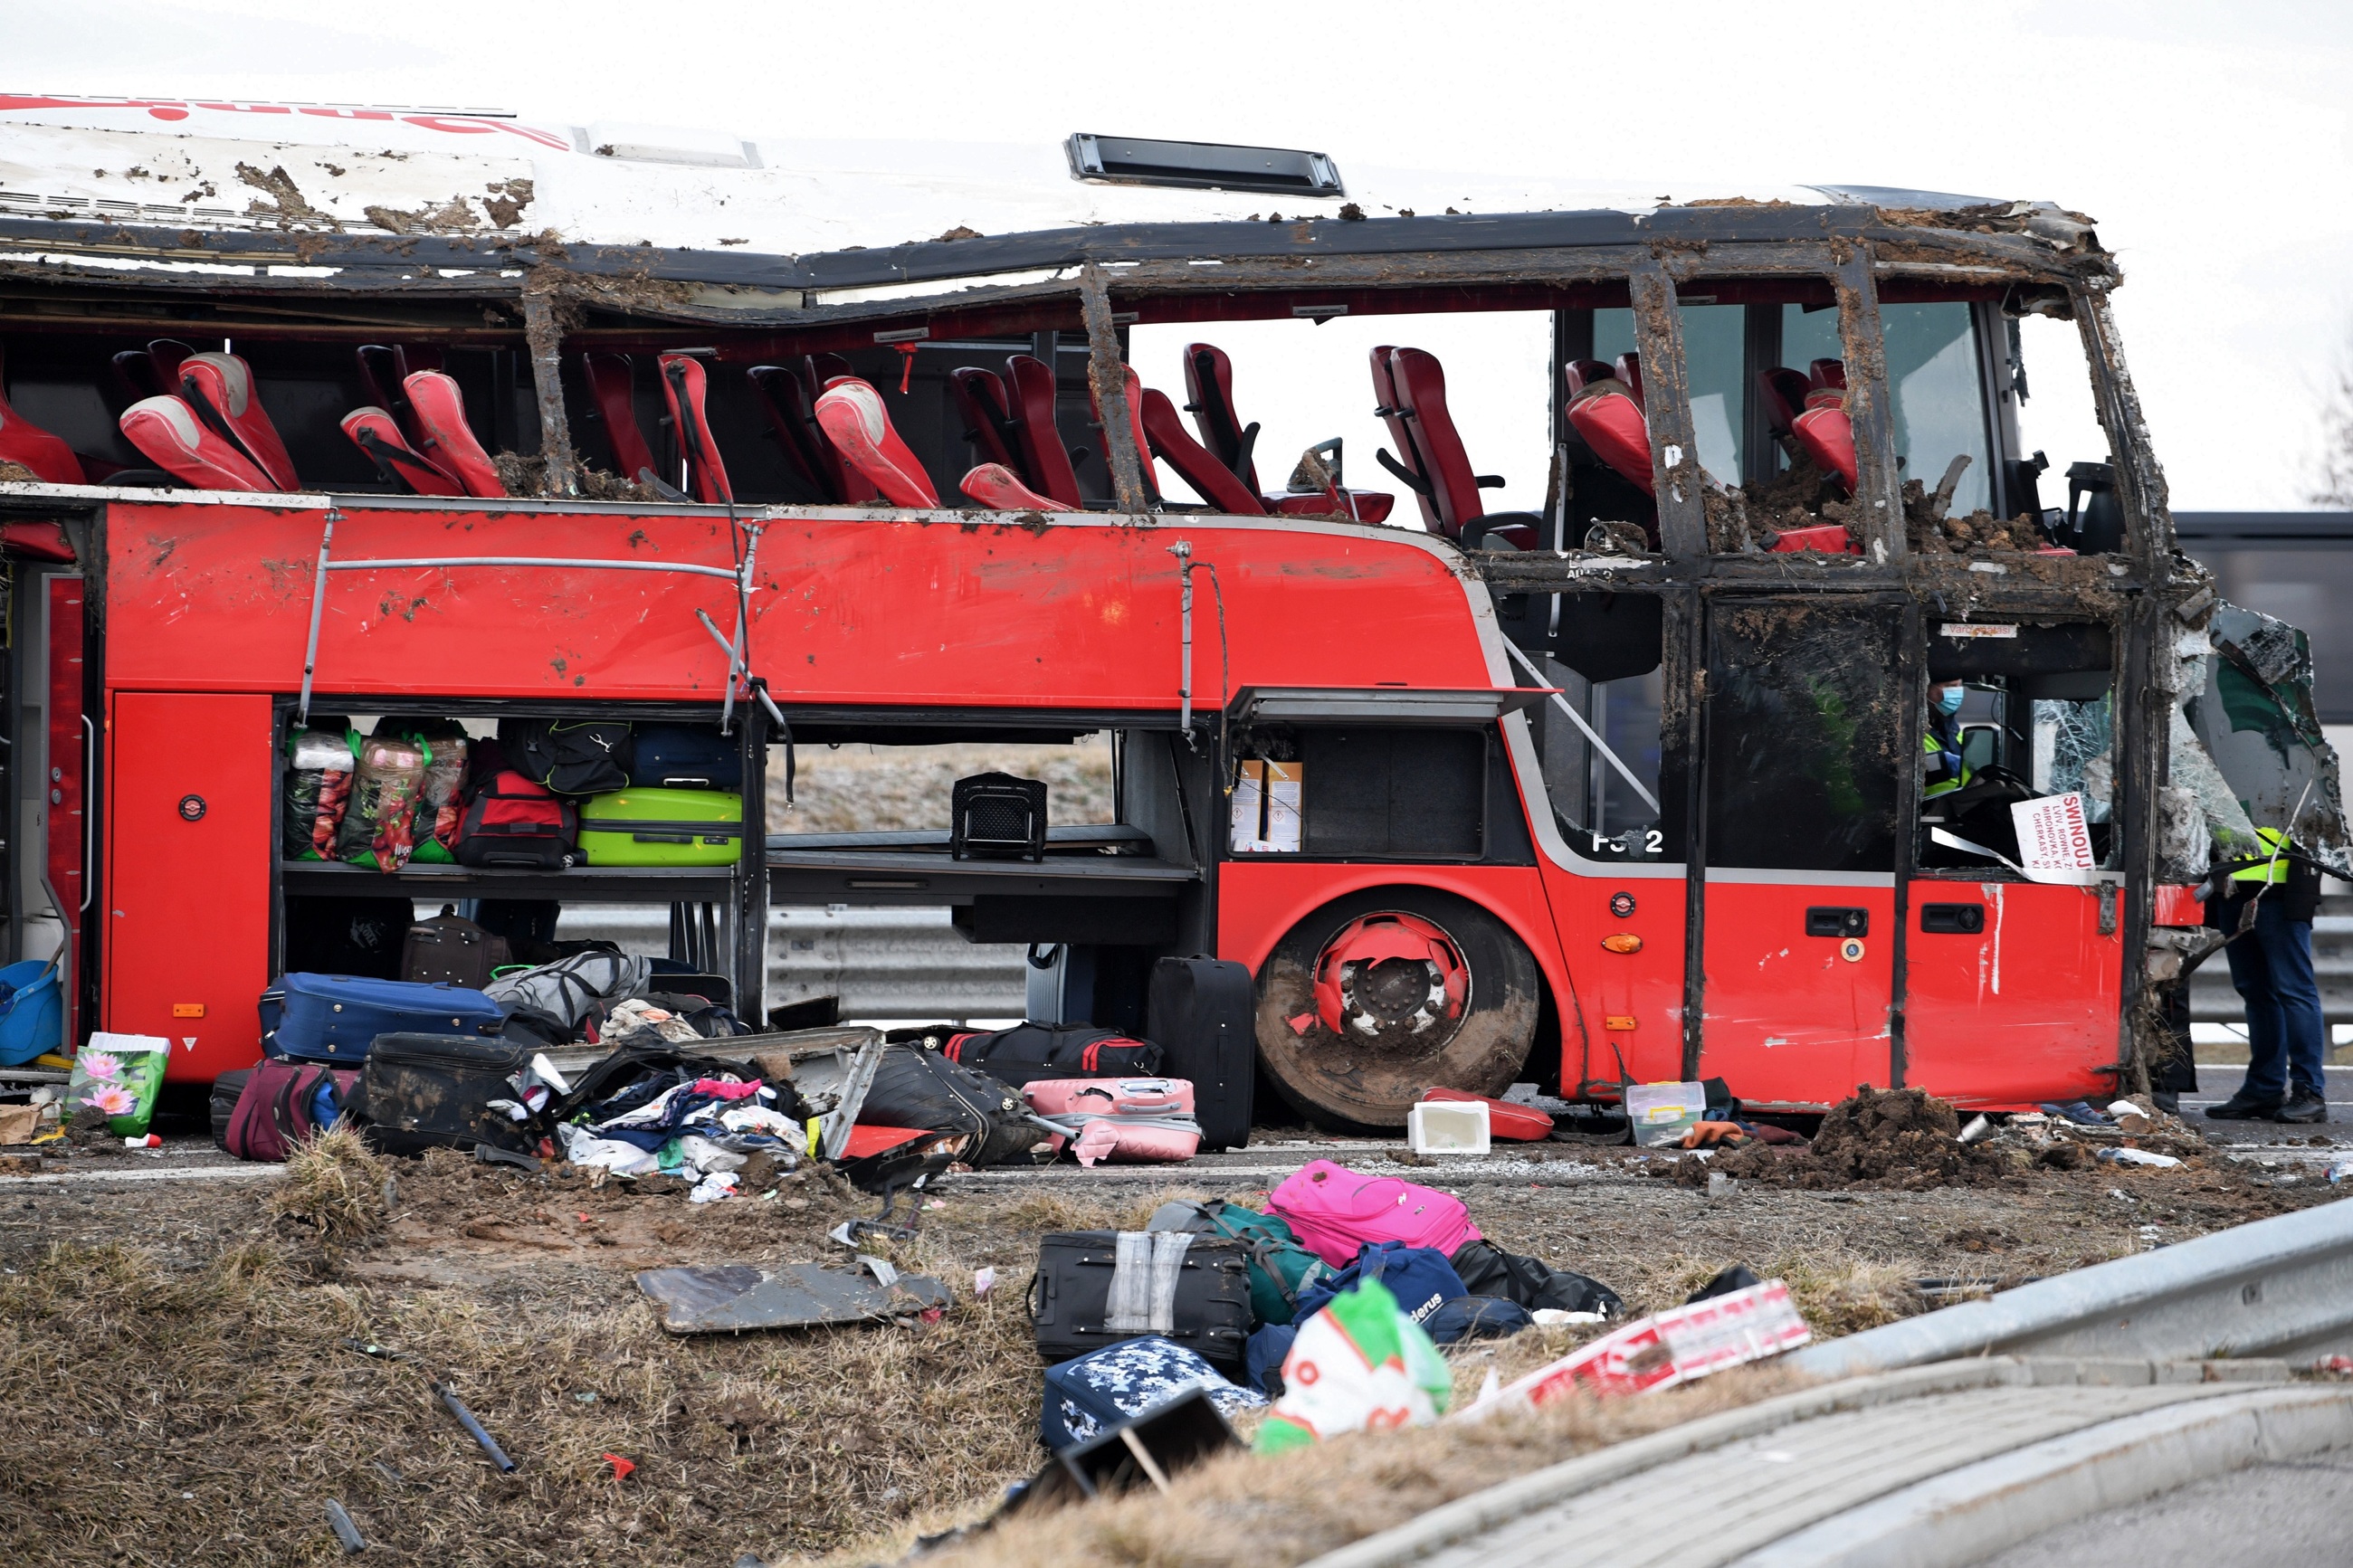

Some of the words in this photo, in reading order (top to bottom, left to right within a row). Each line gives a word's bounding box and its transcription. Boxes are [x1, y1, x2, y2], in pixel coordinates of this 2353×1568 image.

[2033, 813, 2049, 859] CHERKASY,
[2042, 805, 2059, 858] MIRONOVKA,
[2053, 805, 2063, 826] LVIV,
[2063, 796, 2091, 868] SWINOUJ
[2057, 828, 2071, 860] ROWNE,
